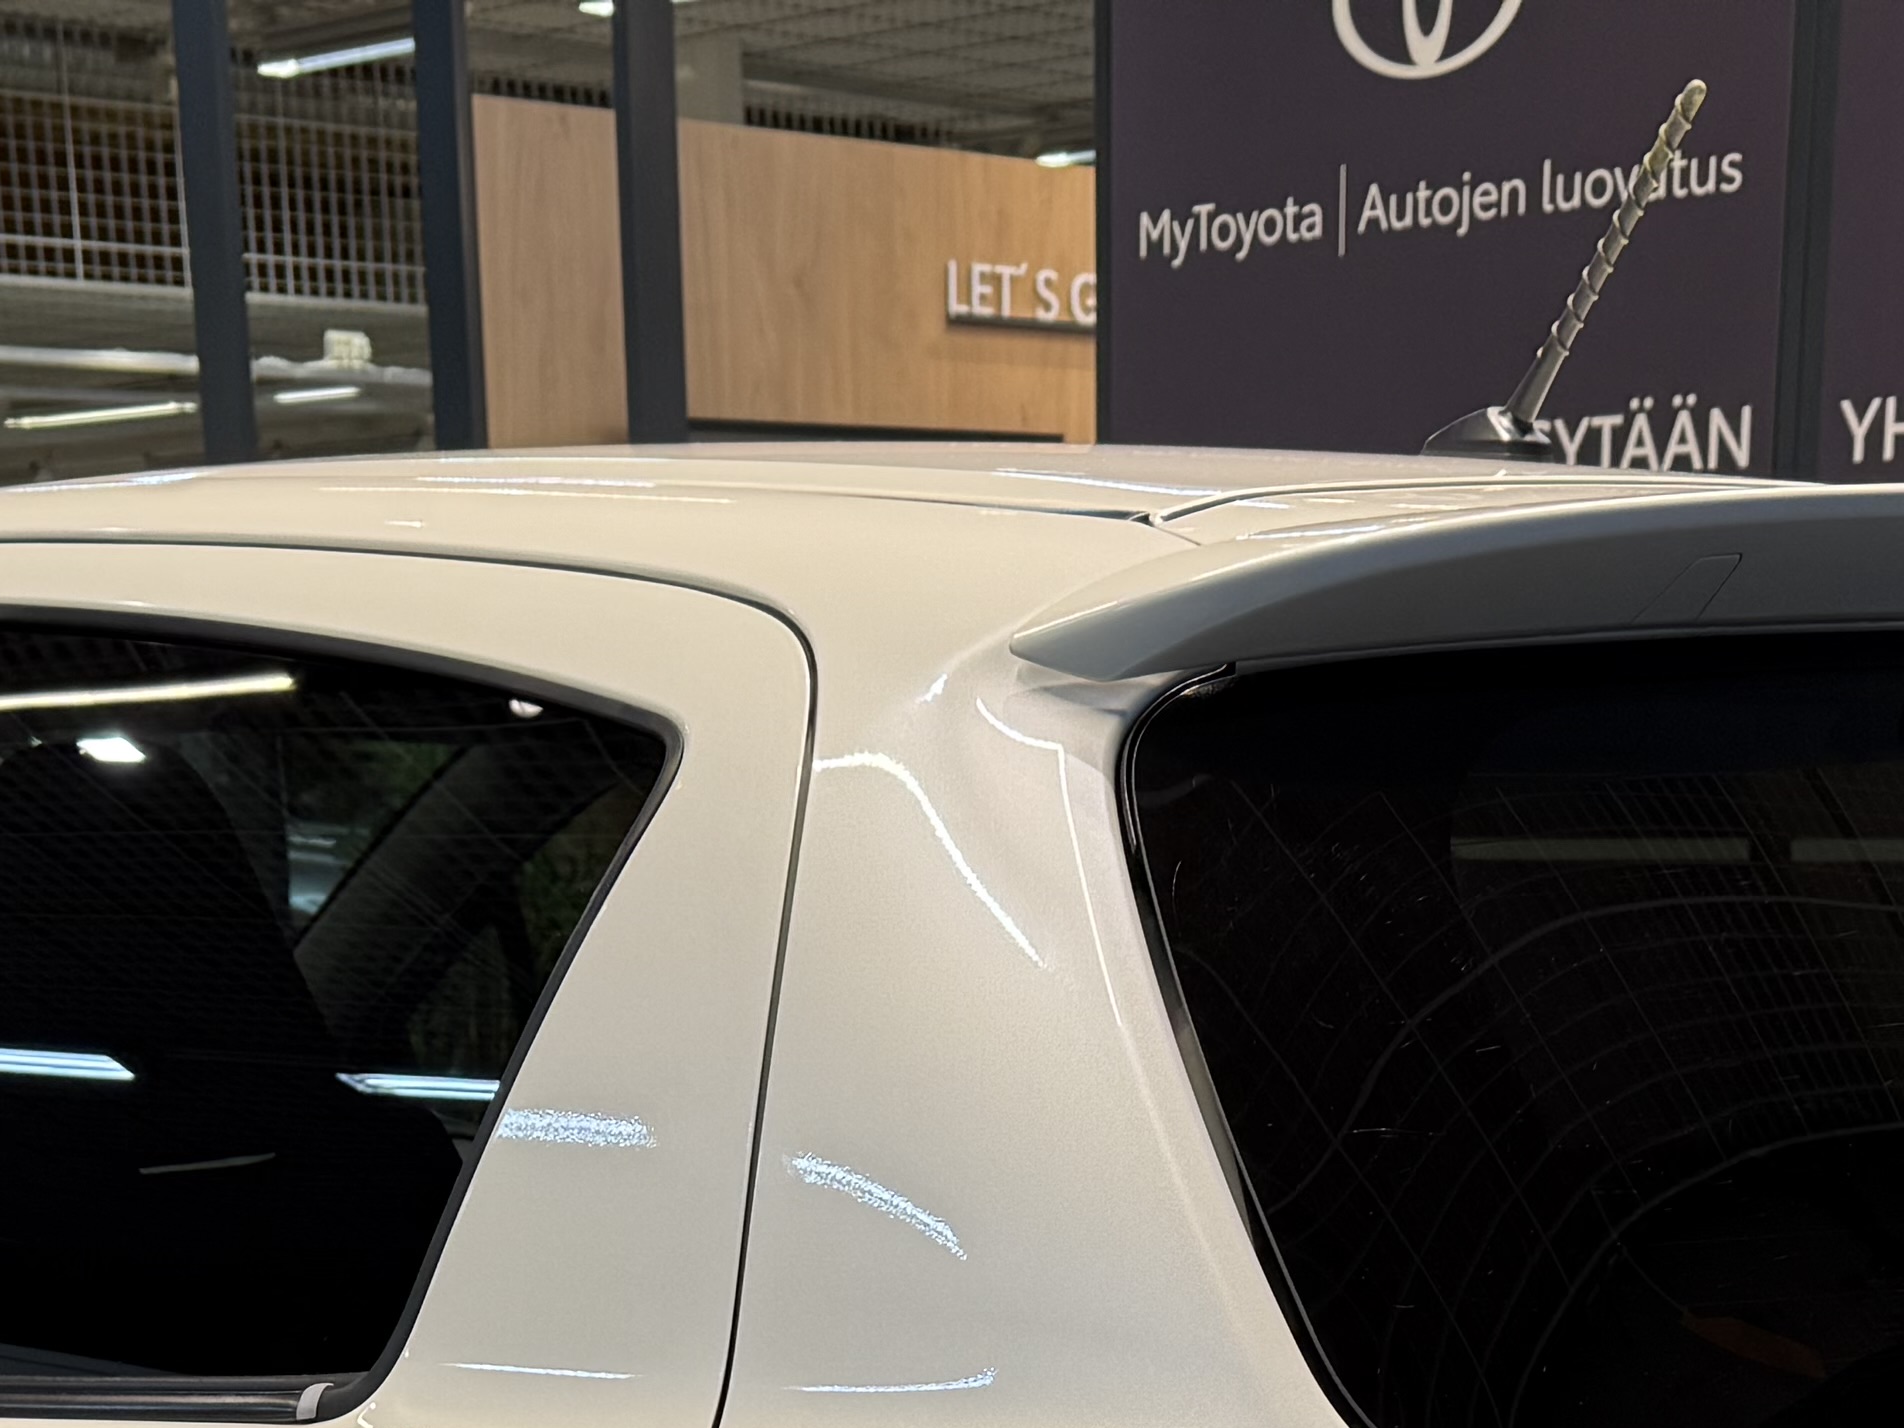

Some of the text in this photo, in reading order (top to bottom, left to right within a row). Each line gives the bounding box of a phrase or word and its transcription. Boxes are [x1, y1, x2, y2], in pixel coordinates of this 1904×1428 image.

[1139, 196, 1324, 268] MyToyota
[1357, 171, 1527, 238] Autojen
[1533, 393, 1753, 472] YTÄÄN
